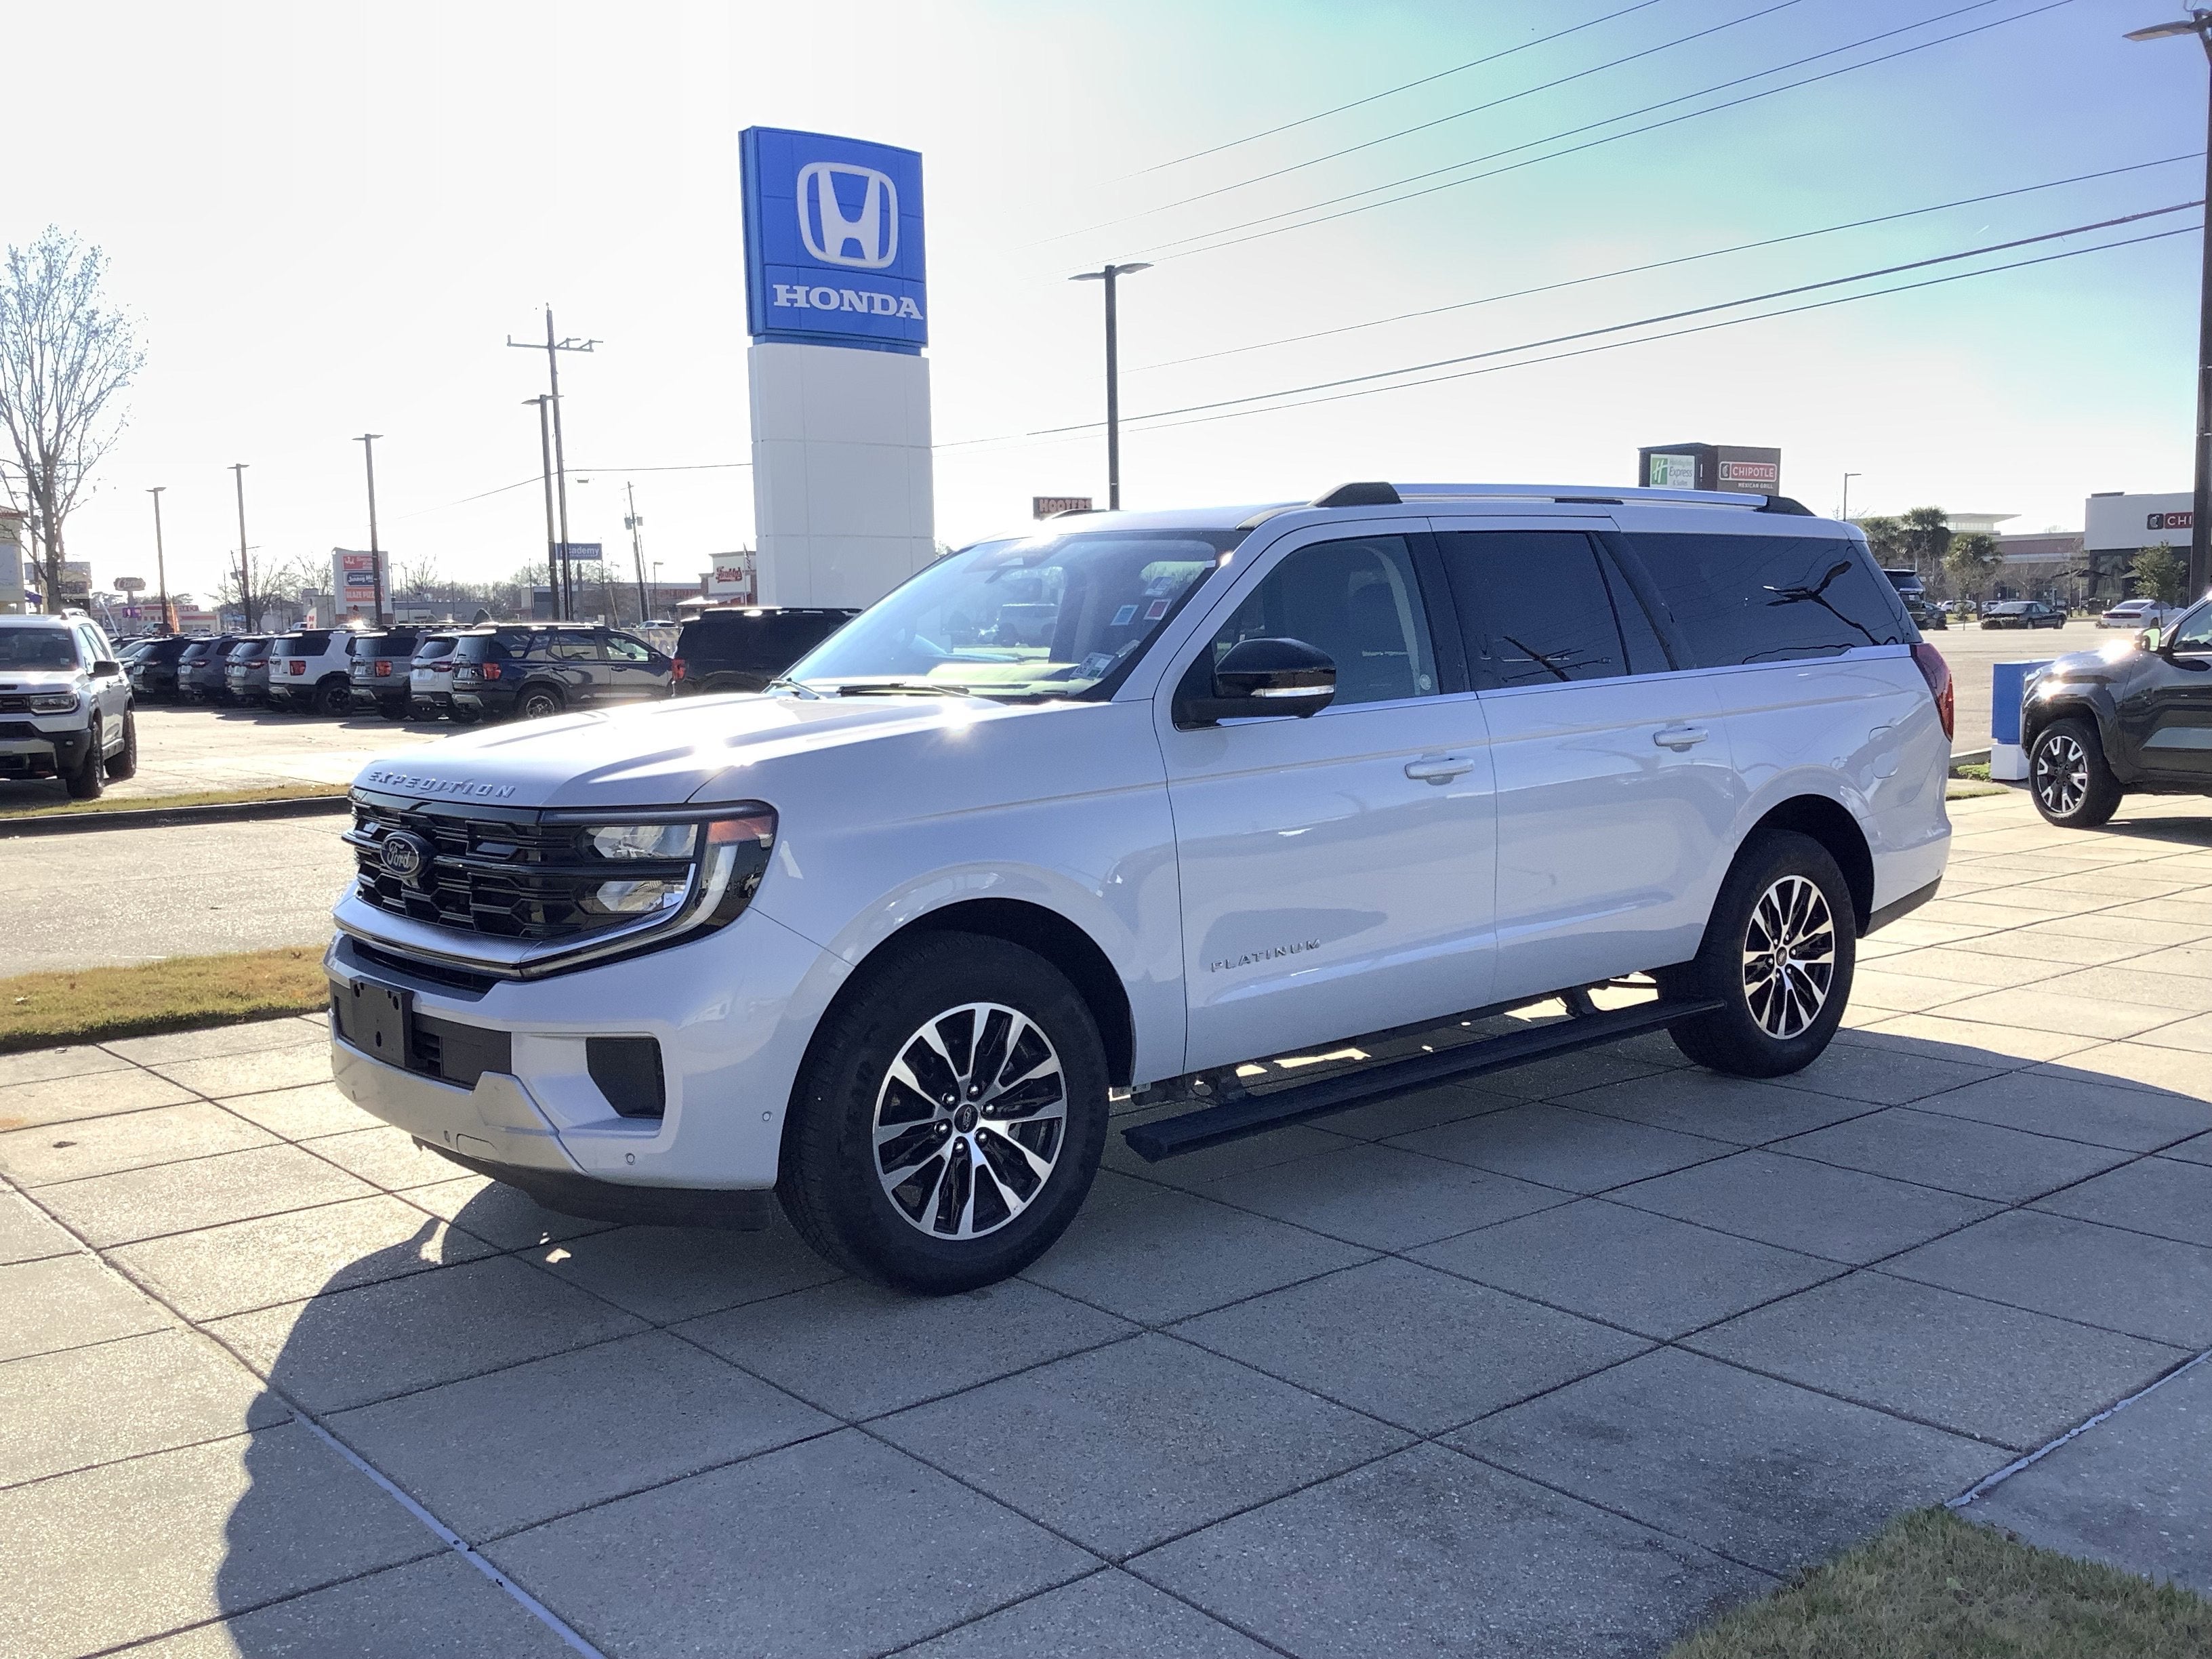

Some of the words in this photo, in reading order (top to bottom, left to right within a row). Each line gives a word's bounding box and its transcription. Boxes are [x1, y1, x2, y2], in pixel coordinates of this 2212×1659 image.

[773, 284, 924, 320] HONDA
[1669, 466, 1693, 478] Express
[1732, 466, 1774, 478] CHIPOTLE
[369, 772, 516, 798] EXPEDITION
[387, 840, 411, 868] Ford
[1211, 938, 1320, 972] PLATINUM
